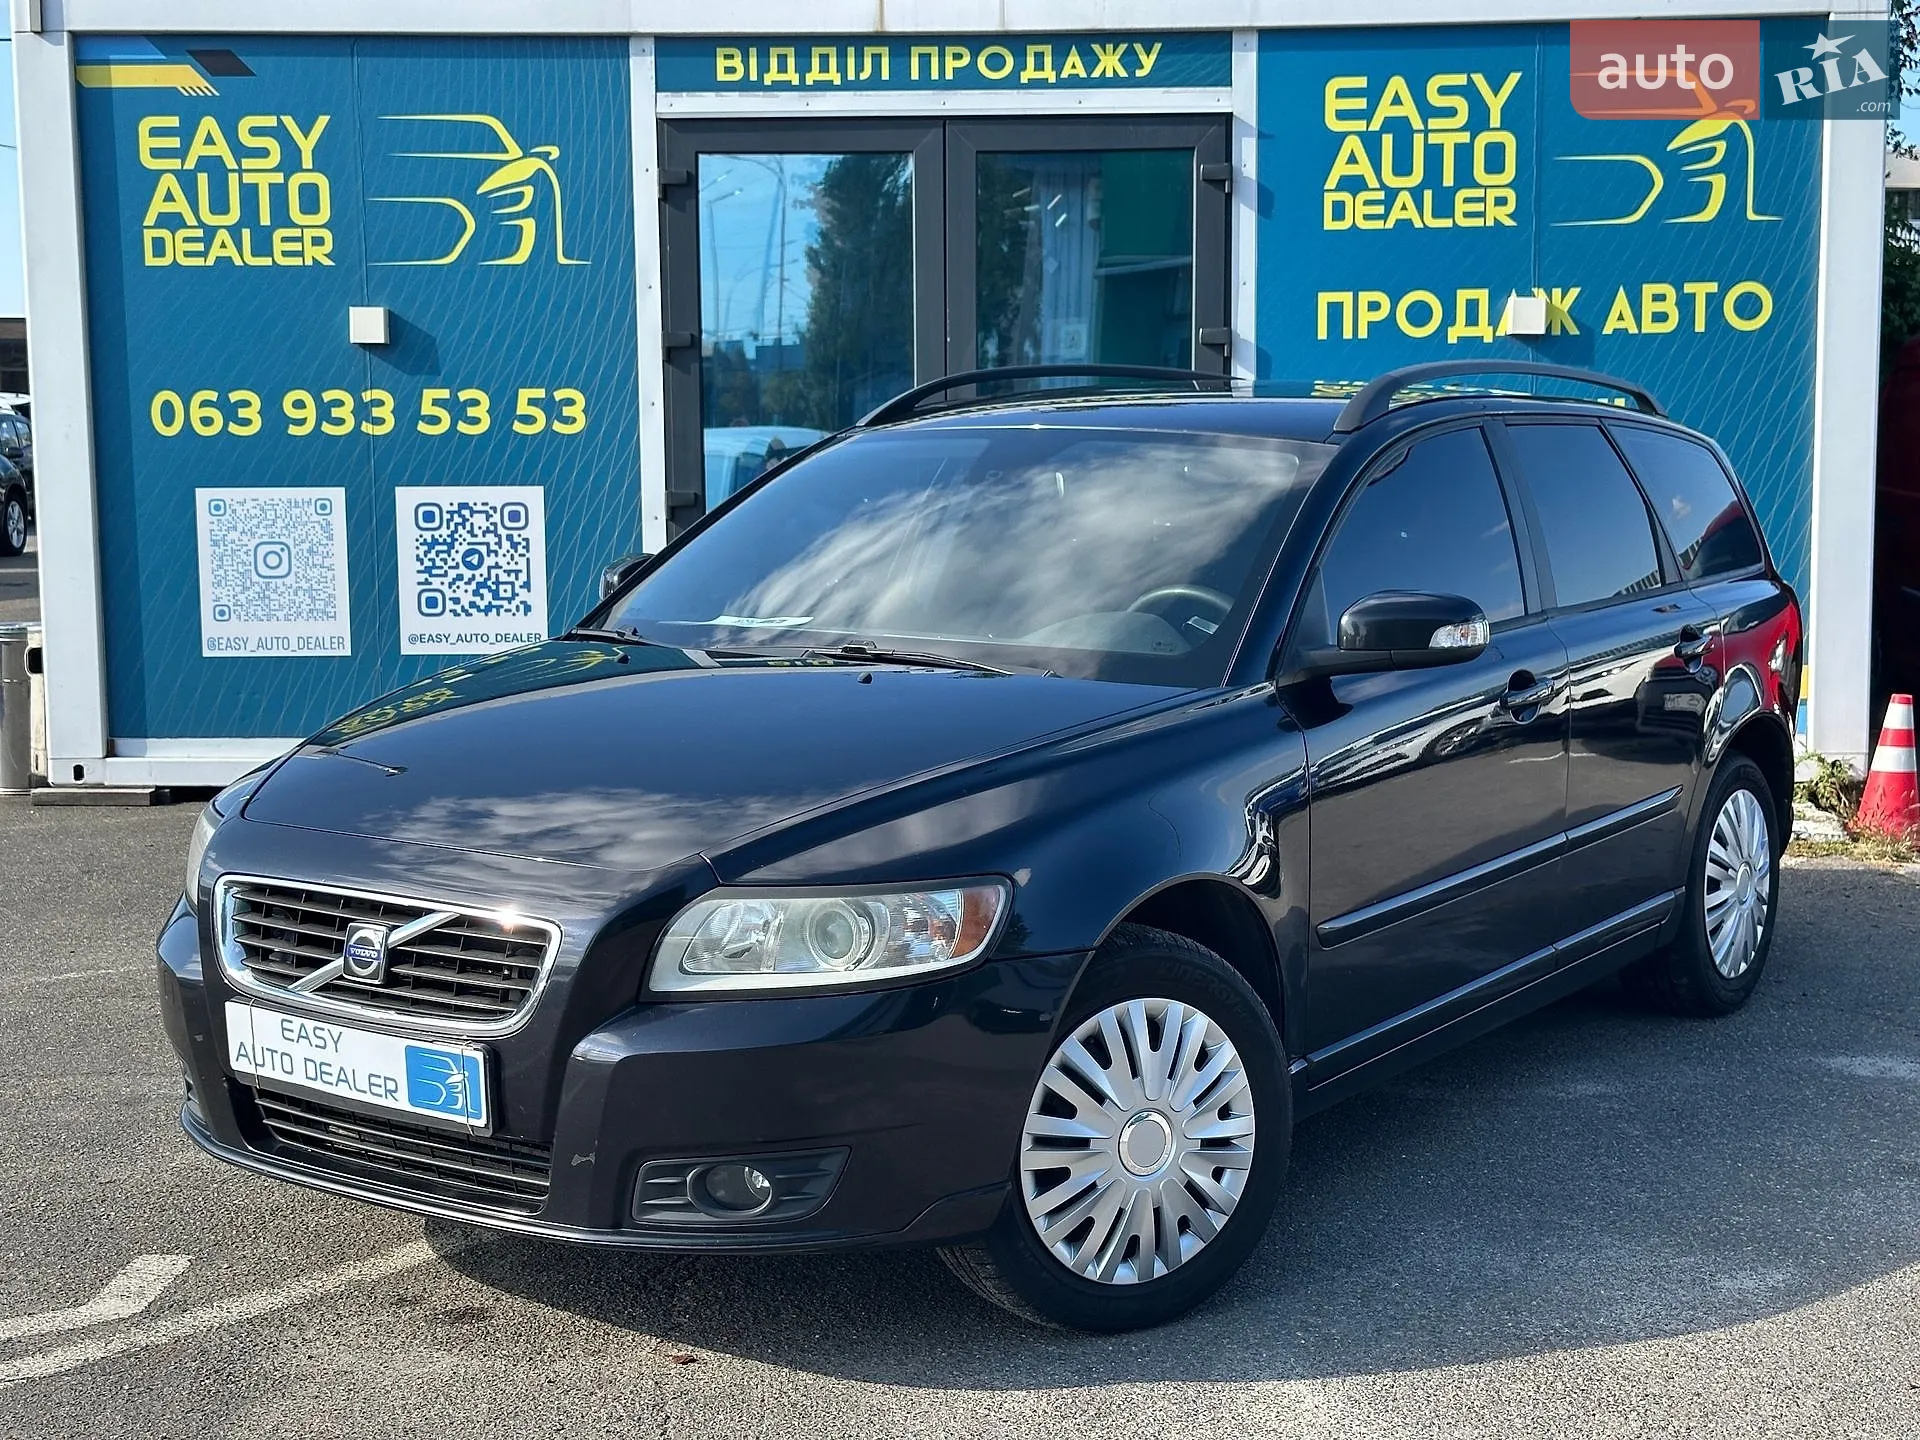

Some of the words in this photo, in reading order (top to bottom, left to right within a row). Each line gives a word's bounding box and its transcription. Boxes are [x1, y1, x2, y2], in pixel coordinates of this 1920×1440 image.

[715, 46, 890, 86] ВІДДІЛ
[911, 42, 1163, 84] ПРОДАЖУ
[1324, 71, 1522, 132] EASY
[138, 115, 331, 170] EASY
[1325, 130, 1517, 189] AUTO
[143, 172, 333, 226] AUTO
[1324, 187, 1518, 230] DEALER
[143, 228, 335, 266] DEALER
[1602, 281, 1773, 335] АВТО
[150, 390, 262, 437] 063
[282, 389, 395, 436] 933
[417, 388, 490, 435] 53
[513, 388, 587, 435] 53
[207, 636, 345, 652] @EASY_AUTO_DEALER
[408, 633, 542, 645] @EASY_AUTO_DEALER
[350, 947, 378, 958] VOLVO
[281, 1018, 342, 1053] EASY
[236, 1042, 293, 1075] AUTO
[304, 1057, 399, 1102] DEALER
